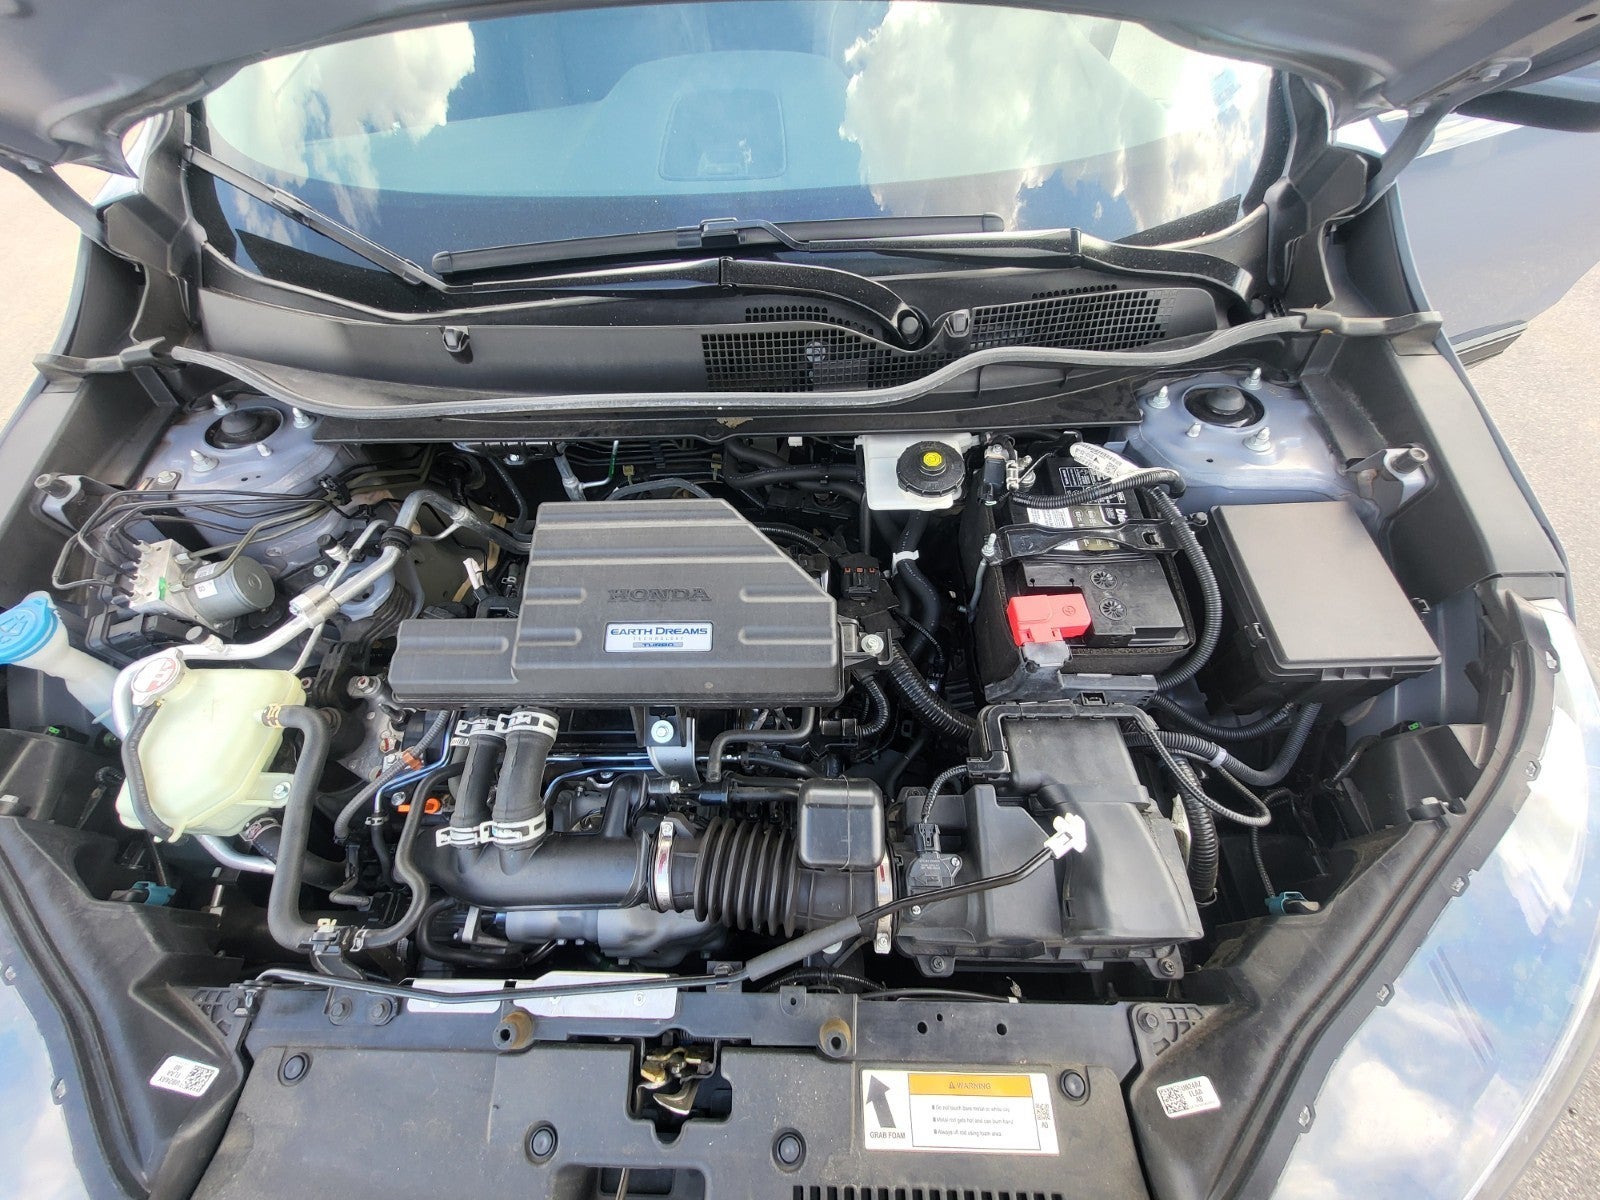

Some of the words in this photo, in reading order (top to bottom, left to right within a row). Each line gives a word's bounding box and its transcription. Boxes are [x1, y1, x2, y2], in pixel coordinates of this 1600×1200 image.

[608, 588, 712, 602] HONDA
[610, 628, 653, 636] EARTH
[655, 627, 708, 635] DREAMS
[956, 1082, 991, 1090] WARNING
[869, 1131, 887, 1139] GRAB
[888, 1131, 906, 1139] FOAM
